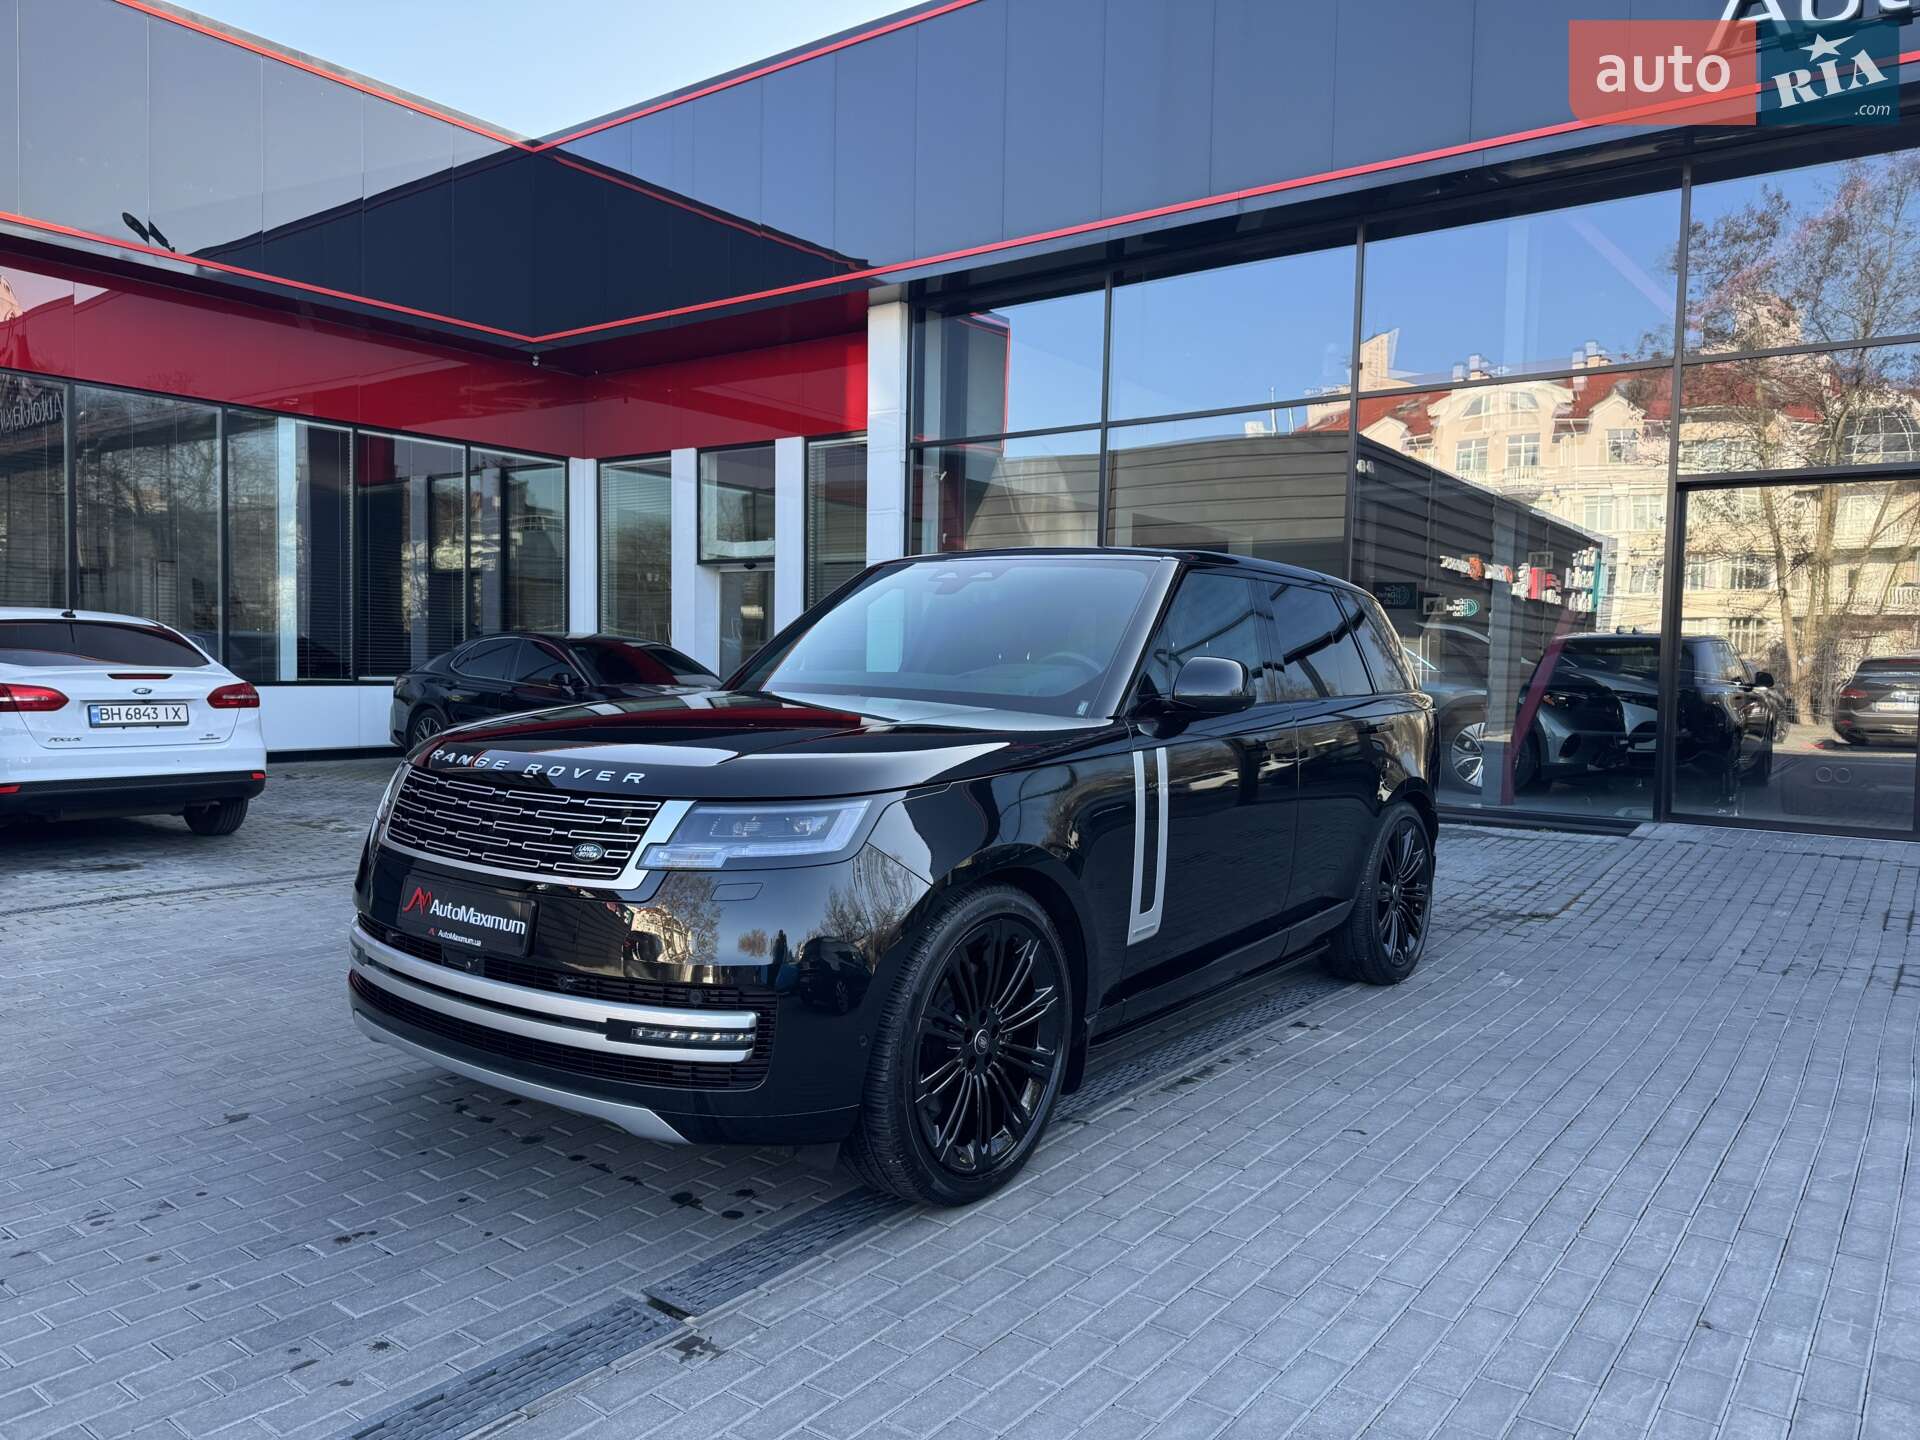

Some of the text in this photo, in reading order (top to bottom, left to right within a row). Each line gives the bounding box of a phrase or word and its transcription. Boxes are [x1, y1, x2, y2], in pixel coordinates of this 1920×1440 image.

[100, 706, 182, 721] BH 6843 IX
[430, 749, 646, 784] RANGE ROVER
[429, 899, 526, 935] AutoMaximum
